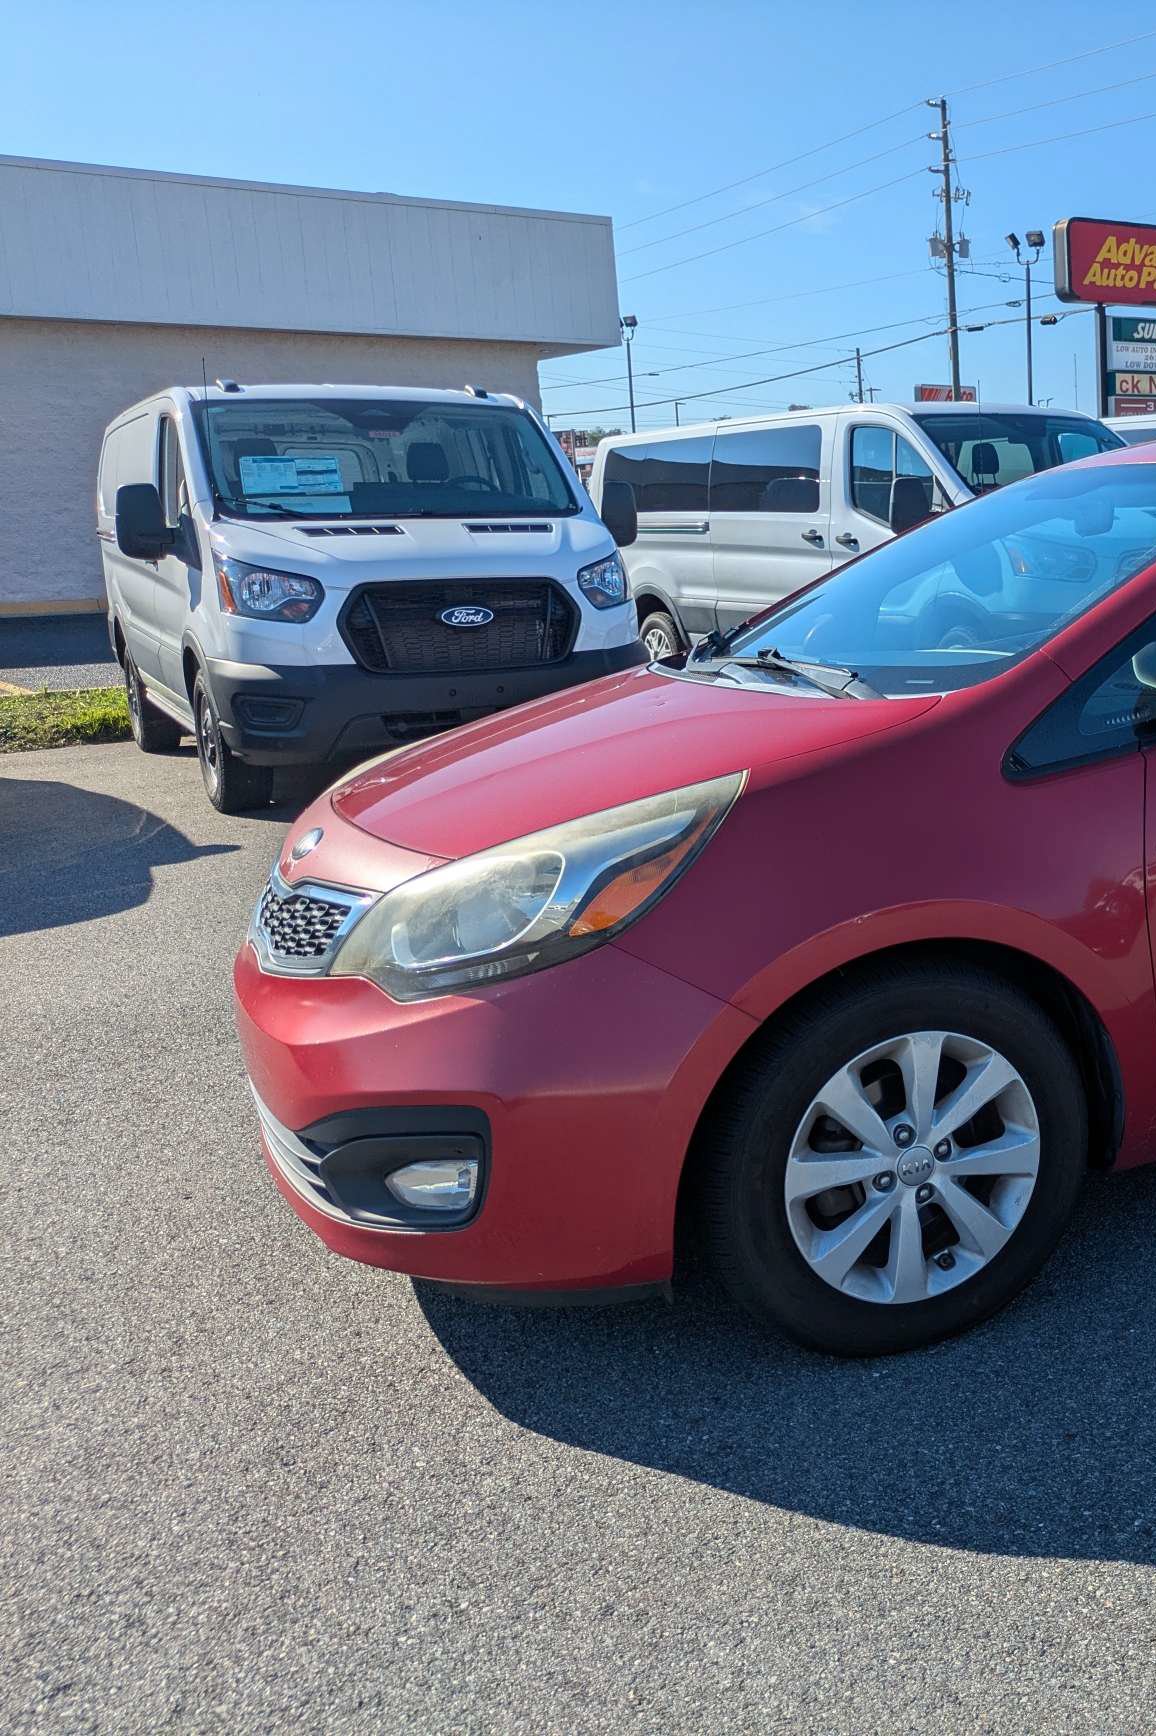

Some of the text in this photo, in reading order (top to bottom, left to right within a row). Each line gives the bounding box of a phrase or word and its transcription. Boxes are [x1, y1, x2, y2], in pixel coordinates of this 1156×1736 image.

[1083, 263, 1138, 288] Auto
[1116, 345, 1129, 353] LOW
[1131, 346, 1148, 354] AUTO
[1125, 361, 1142, 369] LOW
[452, 609, 484, 623] Ford
[902, 1159, 931, 1176] KIA
